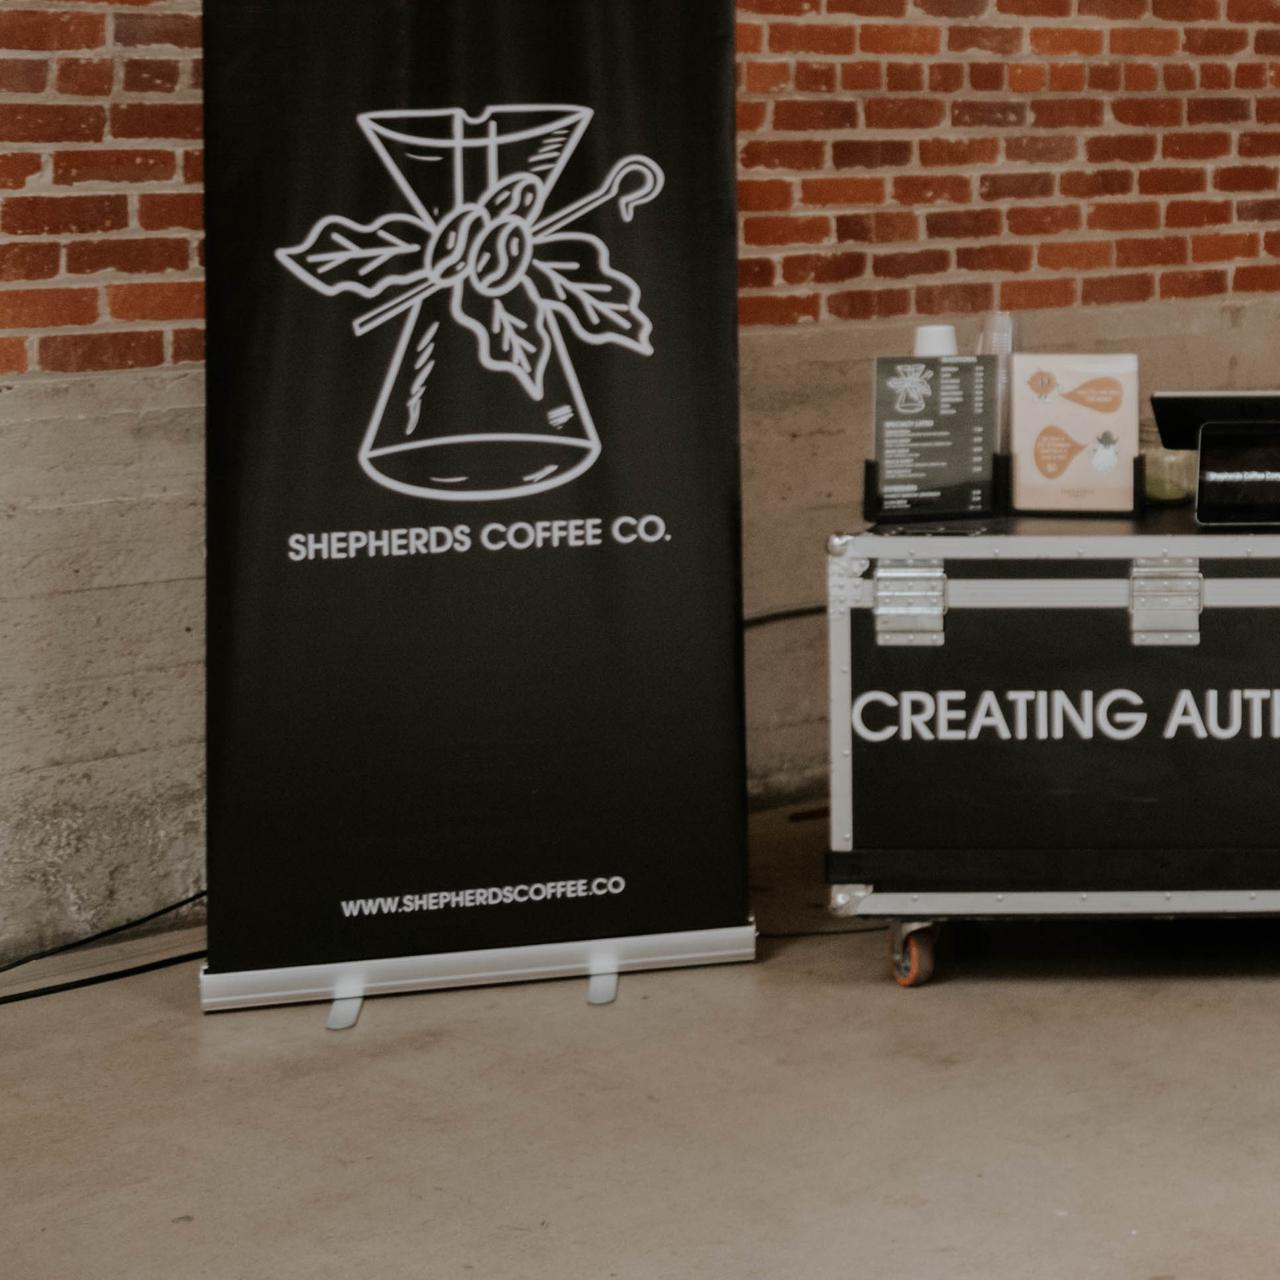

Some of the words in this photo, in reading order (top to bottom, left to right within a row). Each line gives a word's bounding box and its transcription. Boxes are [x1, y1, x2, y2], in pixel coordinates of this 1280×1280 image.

[287, 524, 472, 563] SHEPHERDS
[480, 518, 603, 553] COFFEE
[610, 514, 672, 545] CO.
[851, 688, 1148, 742] CREATING
[340, 875, 626, 918] WWW.SHEPHERDSCOFFEE.CO
